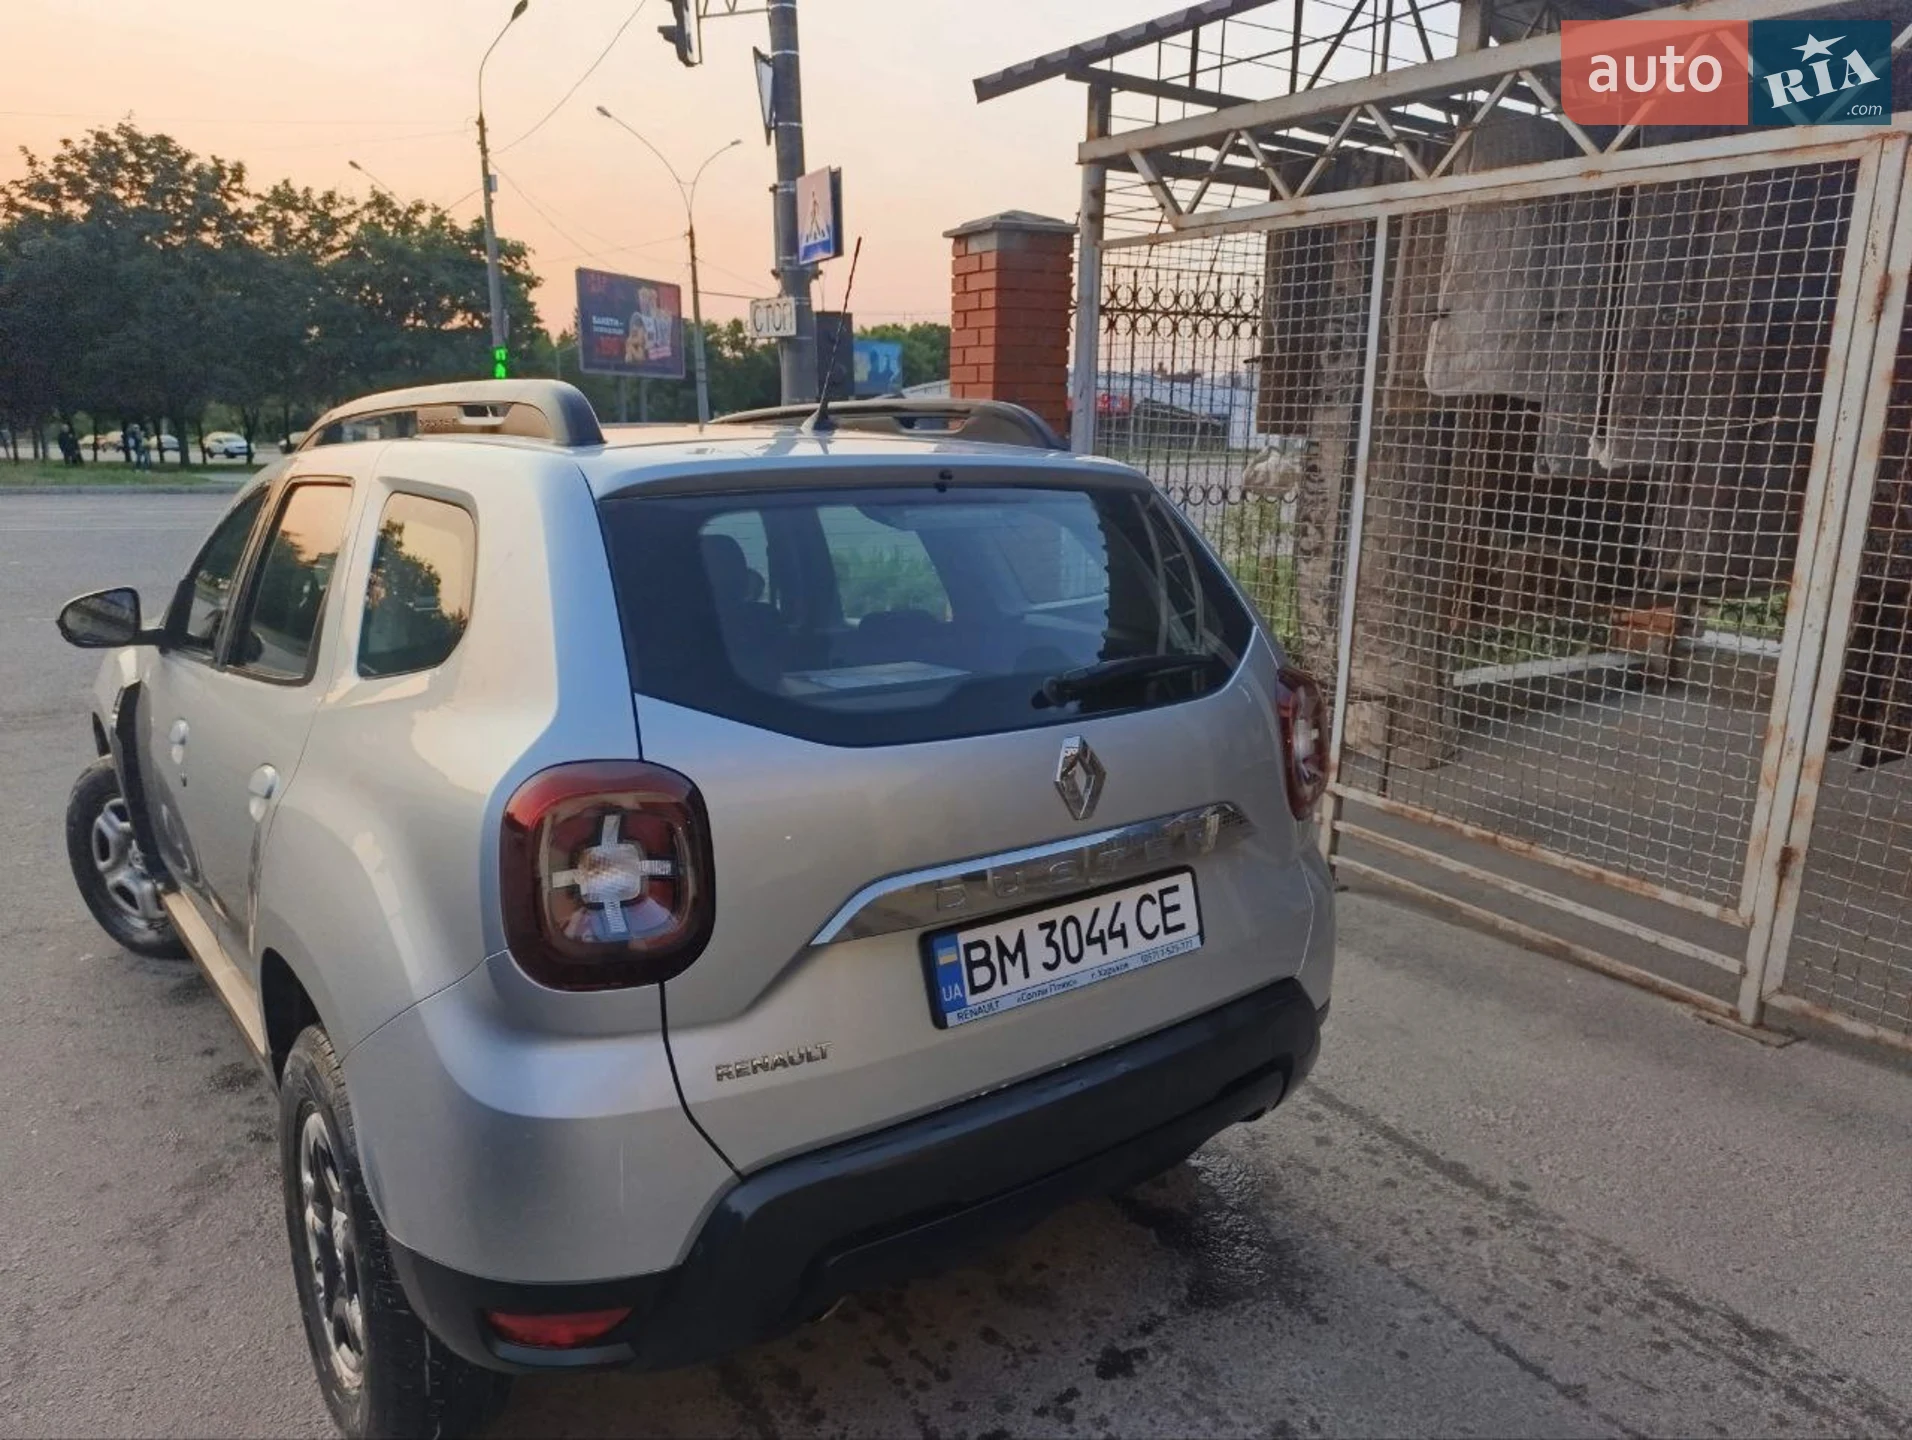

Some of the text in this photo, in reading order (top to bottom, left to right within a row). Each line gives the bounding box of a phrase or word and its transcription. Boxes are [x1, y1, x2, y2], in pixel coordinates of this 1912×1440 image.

[753, 303, 793, 333] СТОП
[962, 884, 1186, 996] BM 3044 CE
[942, 984, 963, 1002] UA
[956, 1000, 1000, 1022] RENAULT
[715, 1040, 833, 1082] RENAULT
